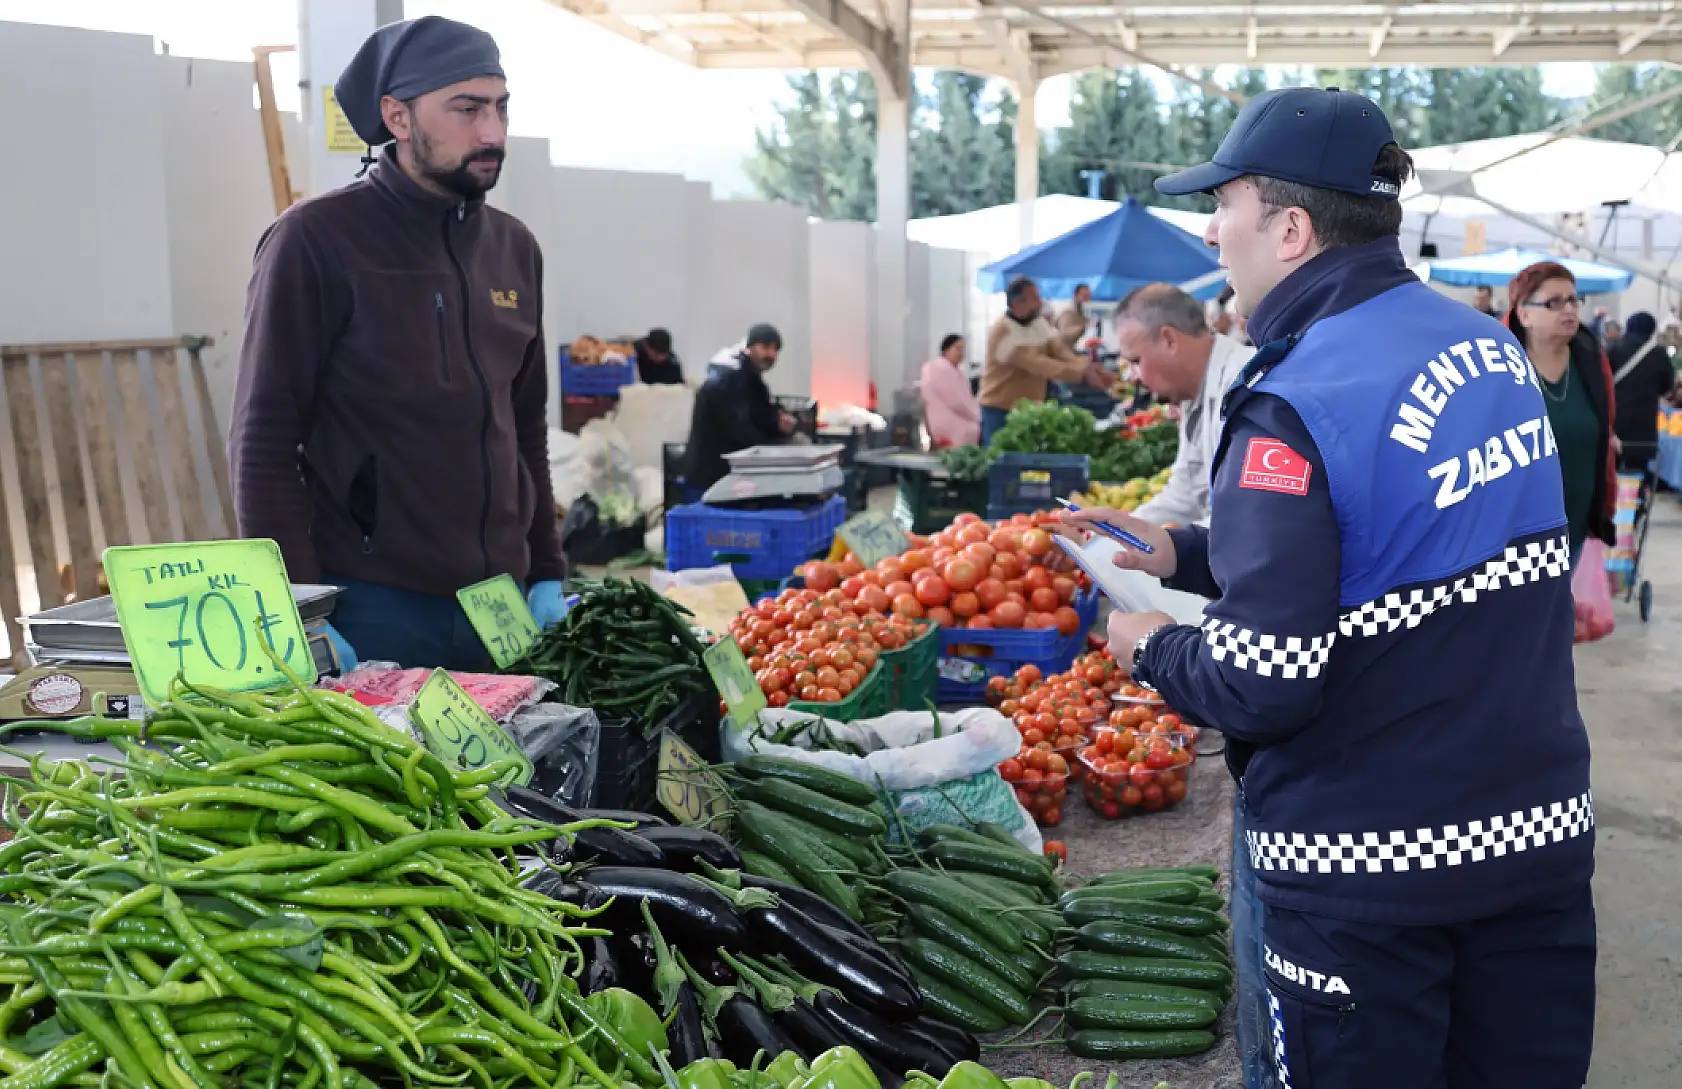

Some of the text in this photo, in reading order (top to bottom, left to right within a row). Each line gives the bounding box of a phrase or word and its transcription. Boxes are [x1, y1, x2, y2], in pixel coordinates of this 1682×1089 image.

[1427, 415, 1559, 510] ZABITA
[130, 558, 205, 585] TATLI
[435, 706, 487, 768] 50
[1263, 943, 1351, 995] ZABITA
